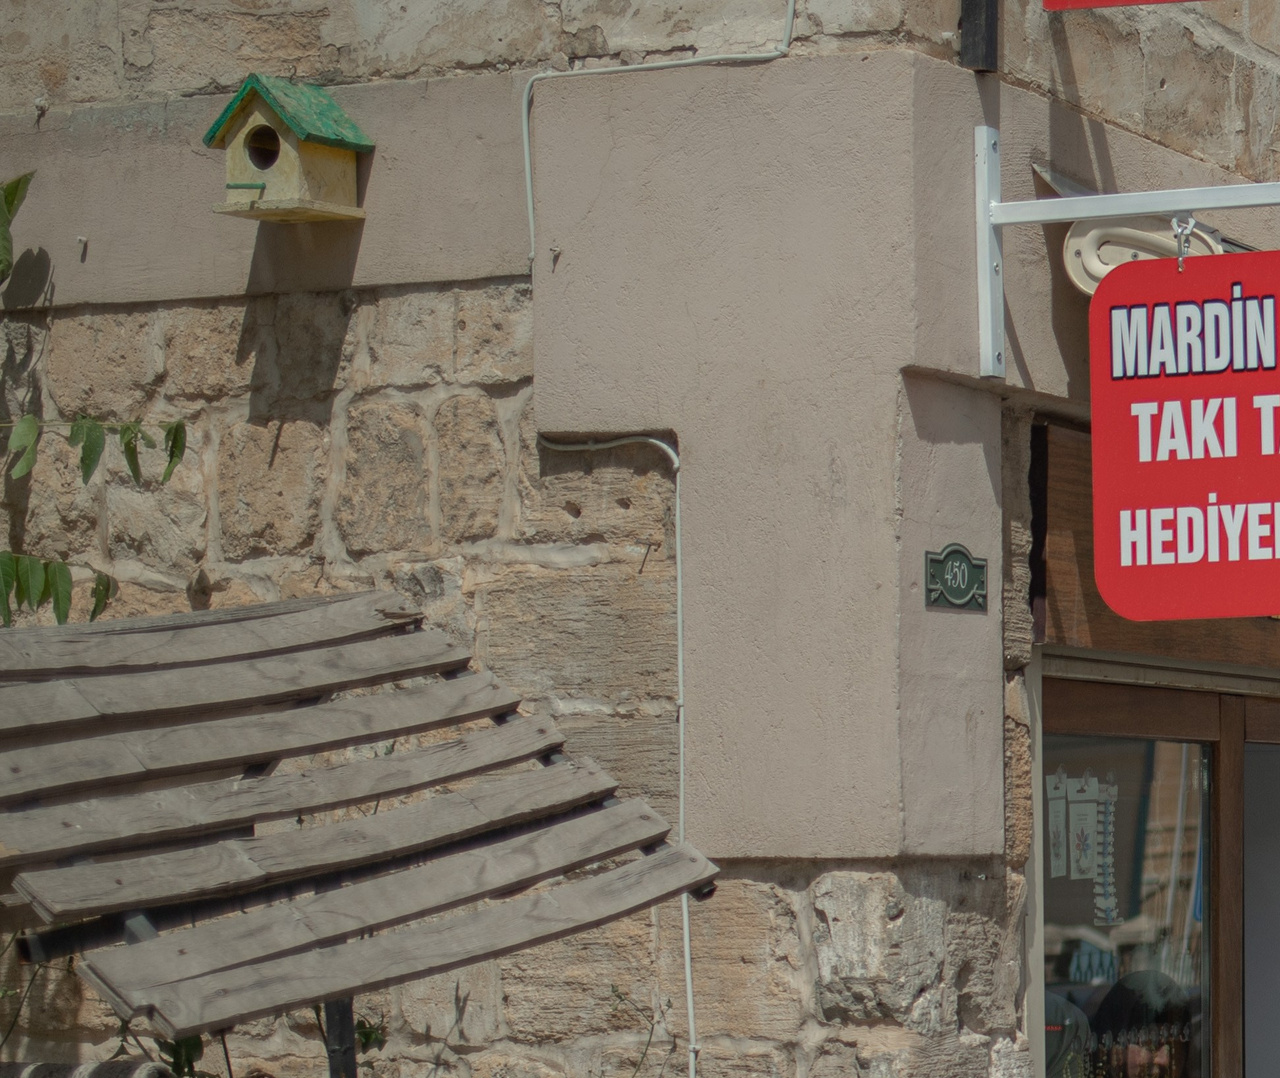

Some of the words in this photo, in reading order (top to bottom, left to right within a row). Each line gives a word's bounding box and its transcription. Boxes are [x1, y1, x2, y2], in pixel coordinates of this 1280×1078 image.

[1110, 283, 1276, 380] MARDİN
[1131, 396, 1237, 463] TAKI
[944, 560, 969, 590] 450
